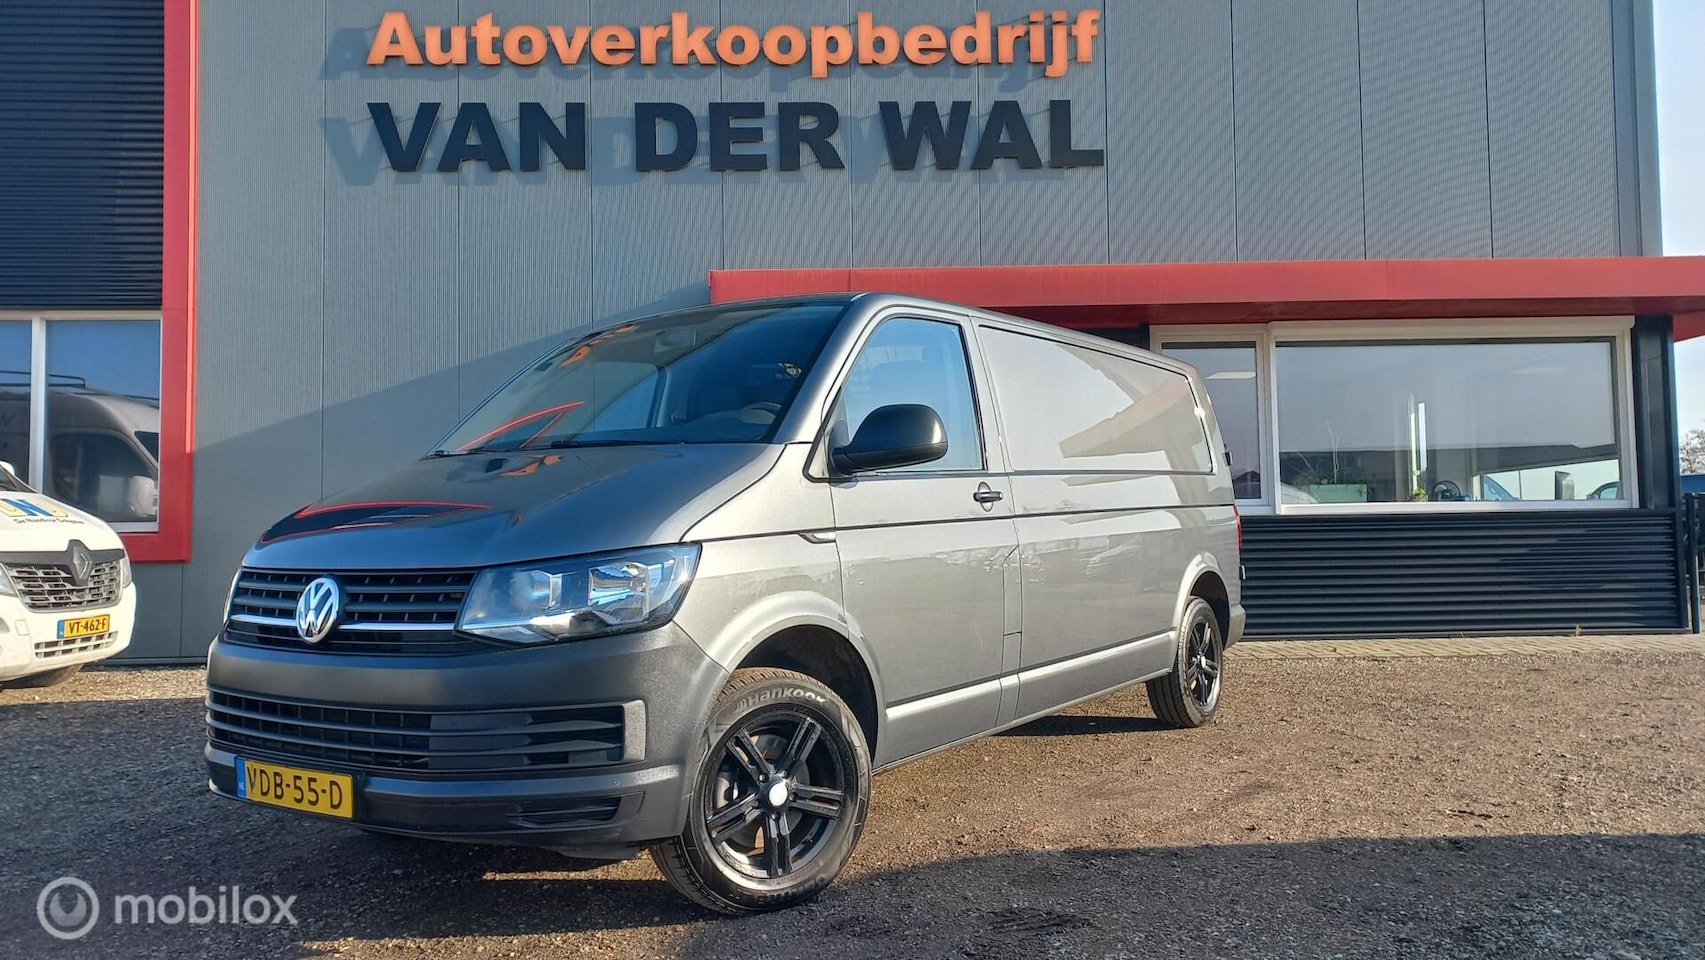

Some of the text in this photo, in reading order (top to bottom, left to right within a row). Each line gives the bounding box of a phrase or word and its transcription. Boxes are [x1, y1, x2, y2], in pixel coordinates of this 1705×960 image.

[366, 10, 1101, 79] Autoverkoopbedrijf
[367, 100, 1105, 172] VAN DER WAL
[69, 617, 107, 635] VT-462-F
[246, 765, 343, 810] VDB-55-D
